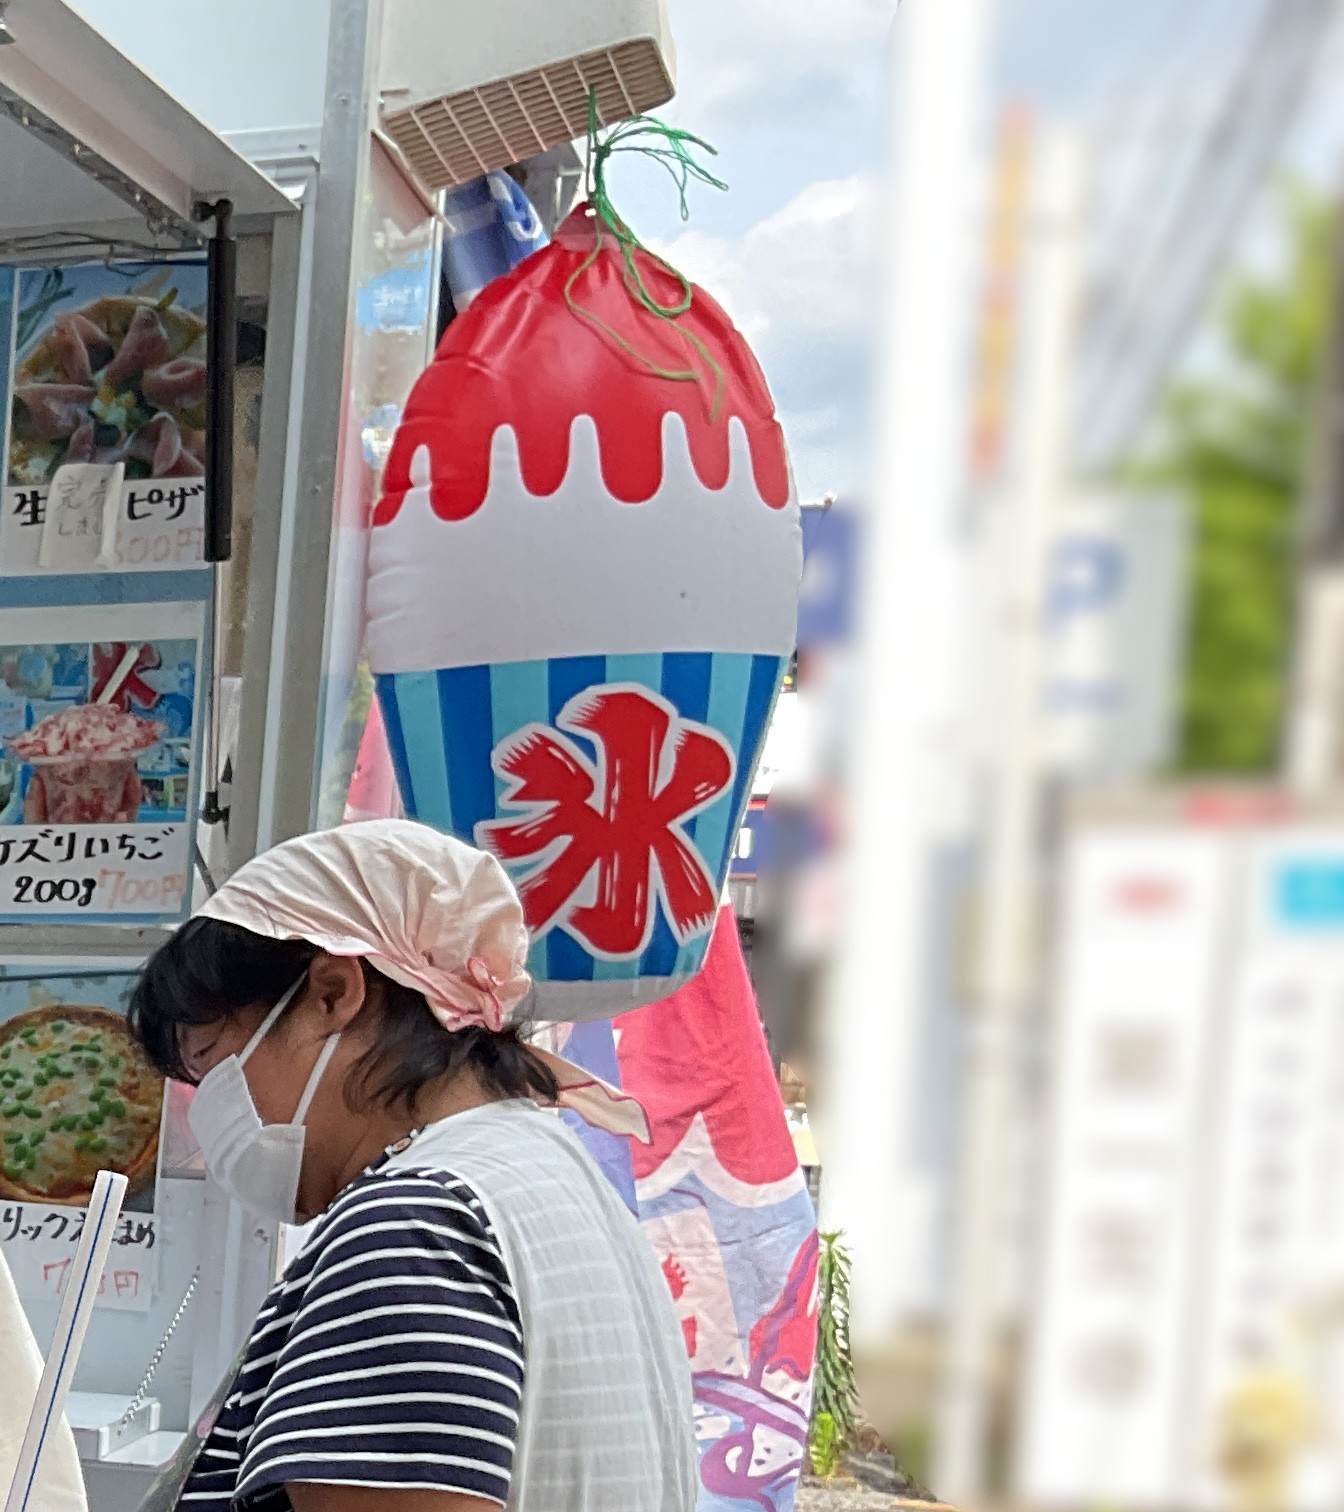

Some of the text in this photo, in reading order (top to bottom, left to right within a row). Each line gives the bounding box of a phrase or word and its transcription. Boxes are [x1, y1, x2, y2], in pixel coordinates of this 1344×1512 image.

[126, 484, 205, 521] ピザ
[113, 526, 205, 565] 00円
[477, 685, 735, 960] 氷
[13, 868, 186, 910] 200g 700円
